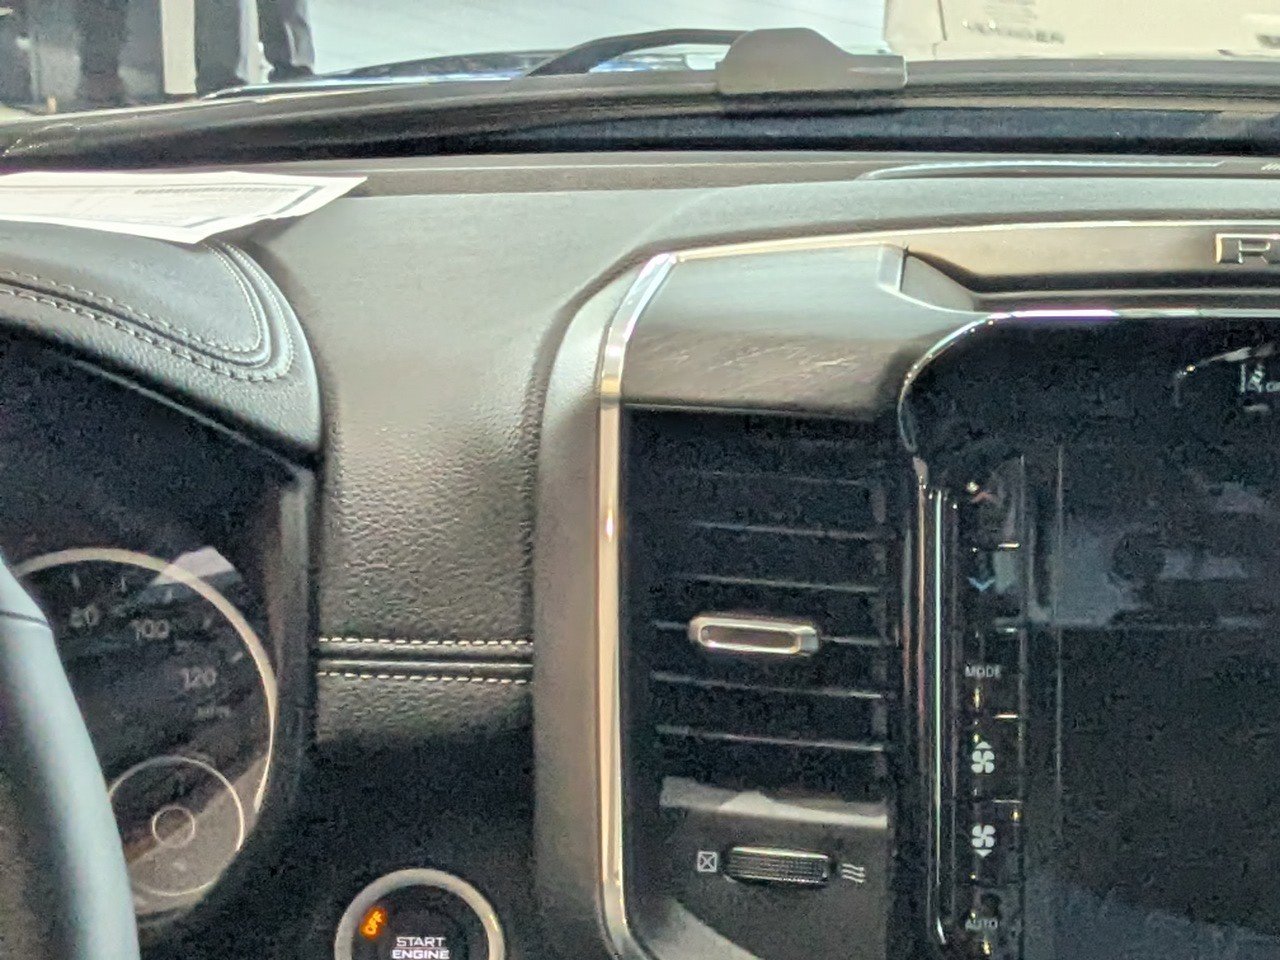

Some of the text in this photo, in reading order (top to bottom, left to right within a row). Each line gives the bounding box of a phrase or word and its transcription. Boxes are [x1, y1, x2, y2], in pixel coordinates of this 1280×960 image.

[360, 911, 383, 936] OFF
[396, 936, 446, 947] START
[391, 950, 449, 959] ENGINE
